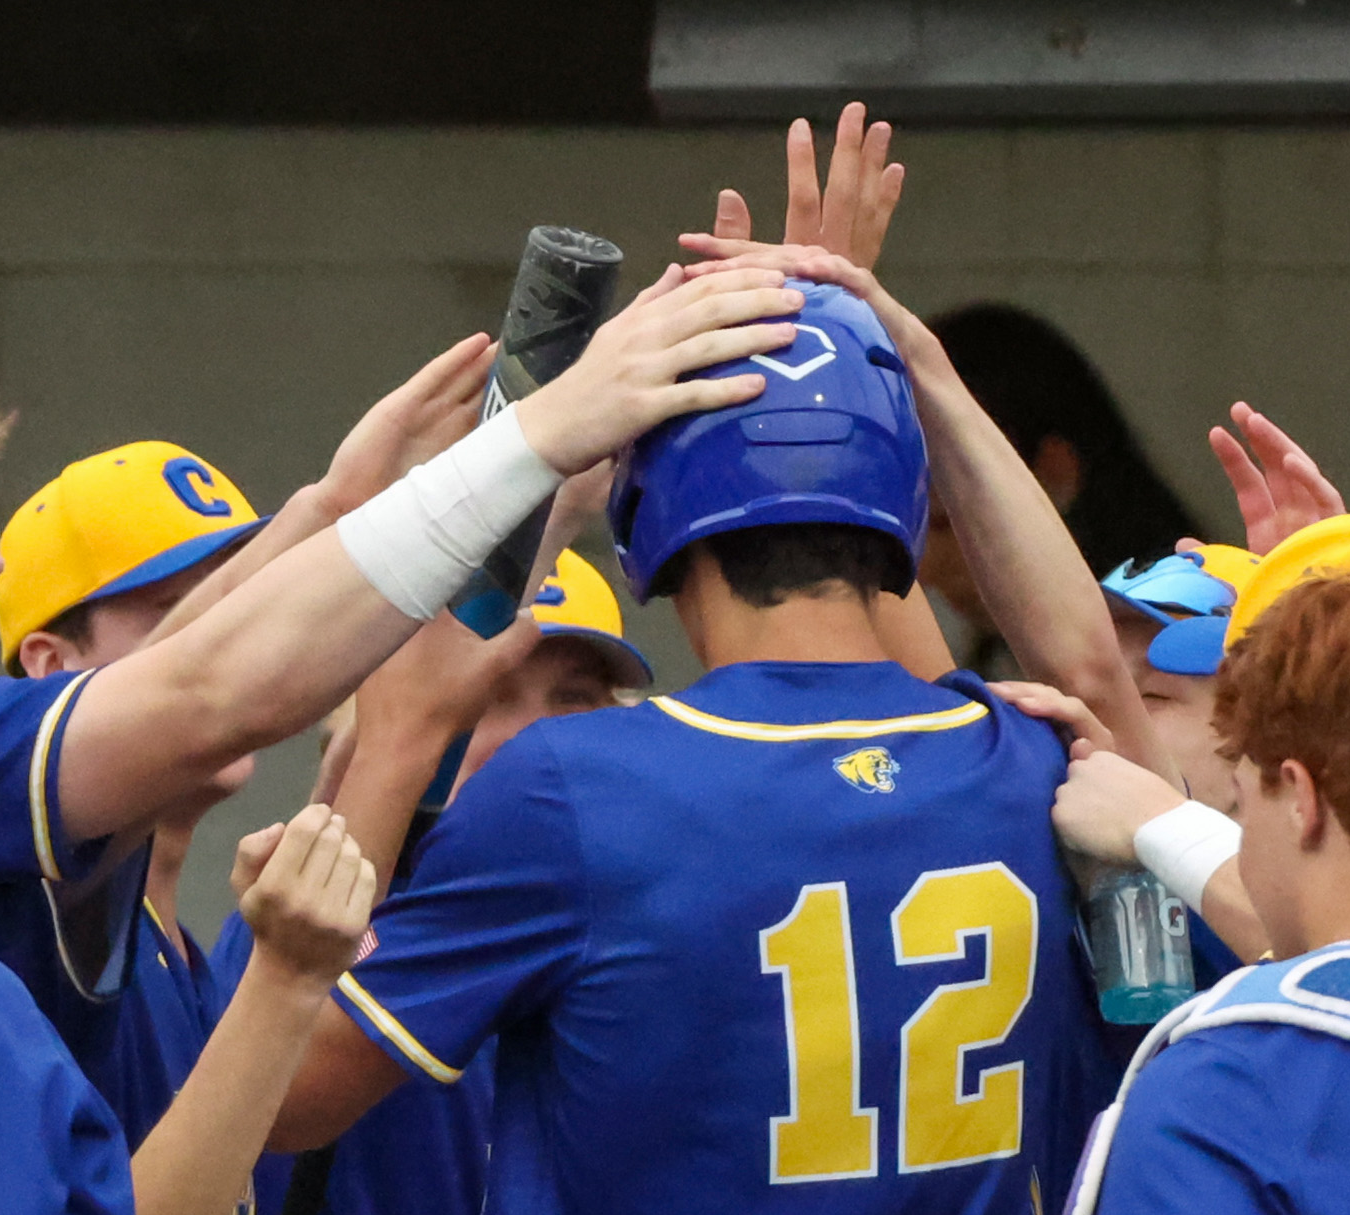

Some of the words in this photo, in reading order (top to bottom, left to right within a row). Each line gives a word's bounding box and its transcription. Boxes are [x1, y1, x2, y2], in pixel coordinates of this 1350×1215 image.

[162, 457, 232, 517] C
[1158, 896, 1185, 937] G
[759, 861, 1038, 1184] 12
